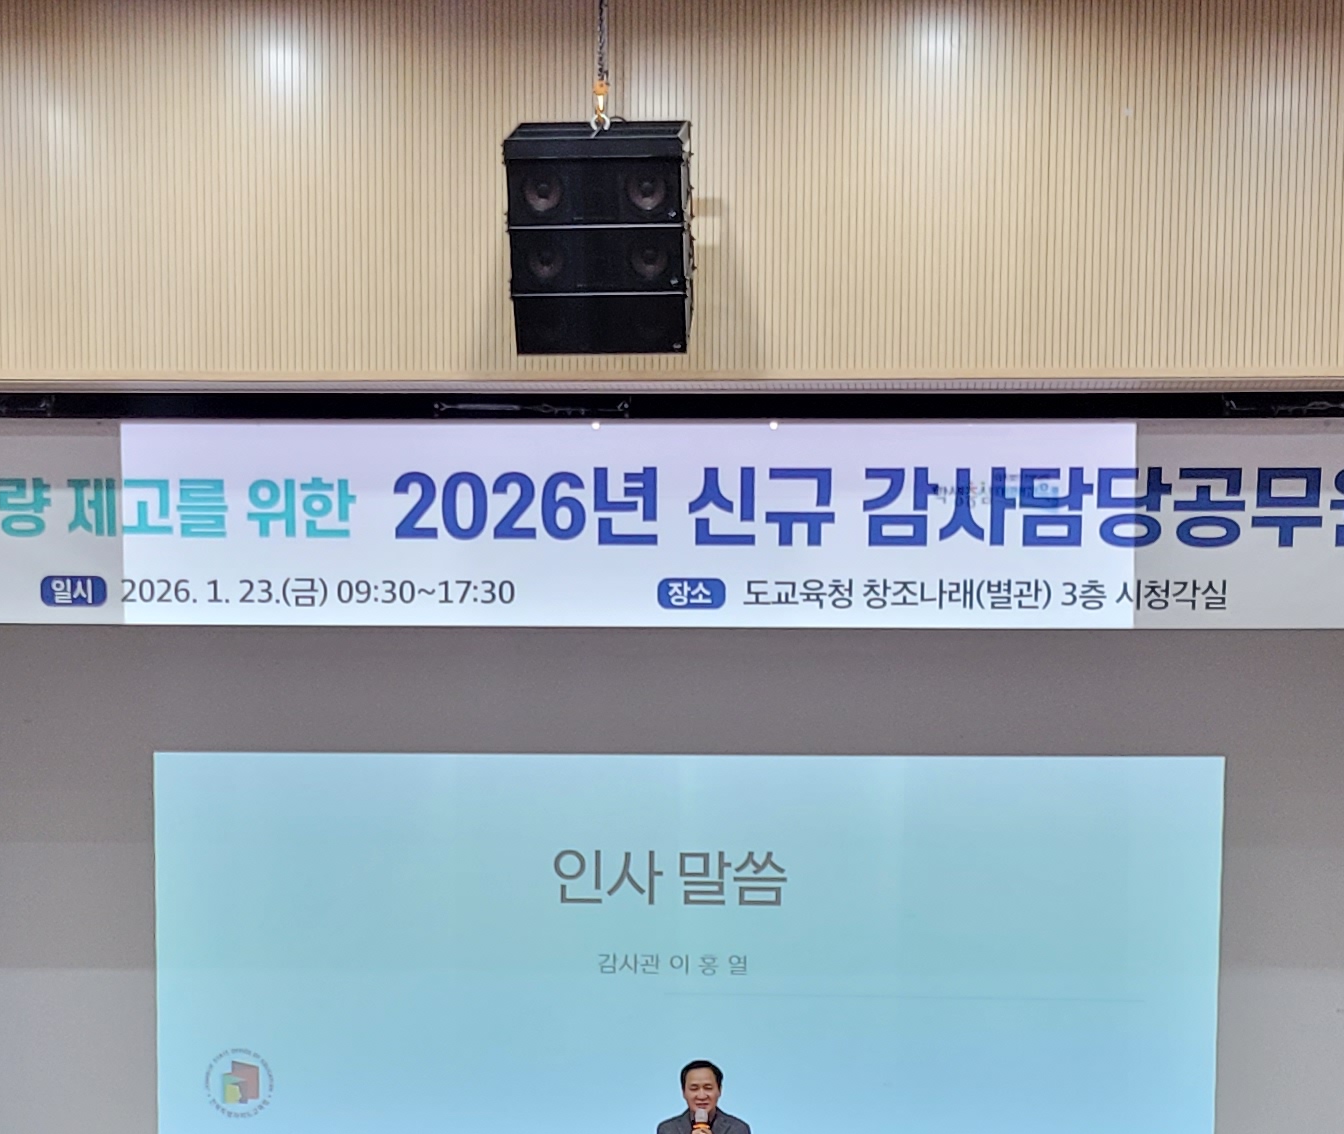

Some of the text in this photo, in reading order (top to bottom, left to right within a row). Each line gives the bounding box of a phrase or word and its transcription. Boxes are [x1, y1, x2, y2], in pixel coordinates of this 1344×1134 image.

[67, 477, 229, 539] 제고를
[246, 477, 357, 539] 위한
[393, 467, 658, 546] 2026년
[688, 467, 836, 547] 신규
[50, 577, 516, 608] 일시 2026. 1. 23.(금) 09:30~17:30
[667, 578, 1228, 611] 장소 도교육청 창조나래(별관) 3층 시청각실
[553, 849, 788, 906] 인사 말씀
[598, 953, 661, 975] 감사관
